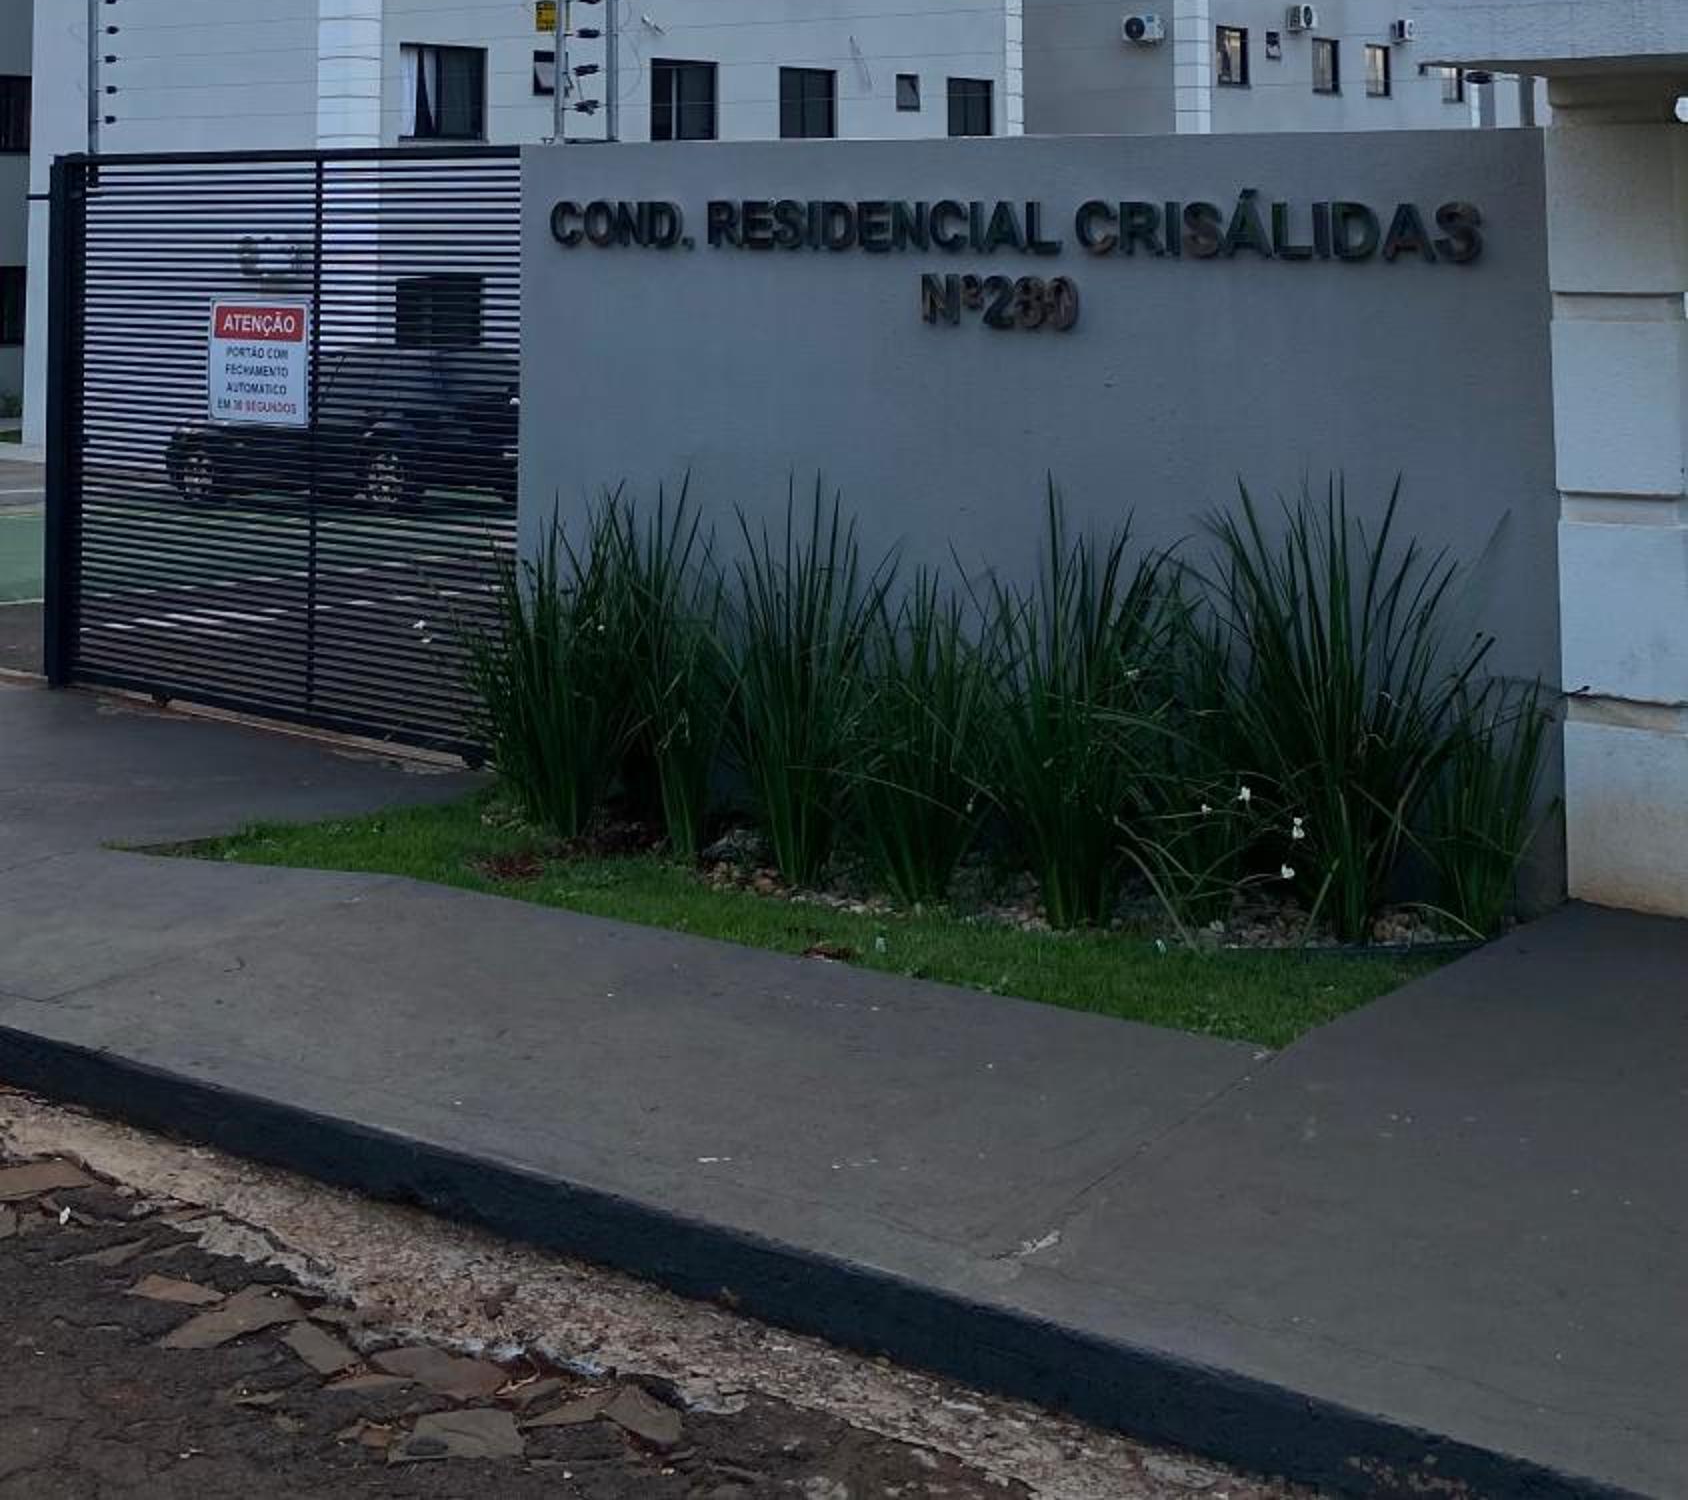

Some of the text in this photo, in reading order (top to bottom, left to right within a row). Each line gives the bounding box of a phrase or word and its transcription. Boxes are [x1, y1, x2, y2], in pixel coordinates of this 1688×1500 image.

[549, 187, 1486, 264] COND. RESIDENCIAL CRISÁLIDAS
[223, 311, 296, 337] ATENÇÃO
[225, 345, 288, 360] PORTÃO COM
[225, 363, 289, 379] FECHAMENTO
[217, 397, 231, 409] EM
[245, 399, 297, 415] SEGUNDOS
